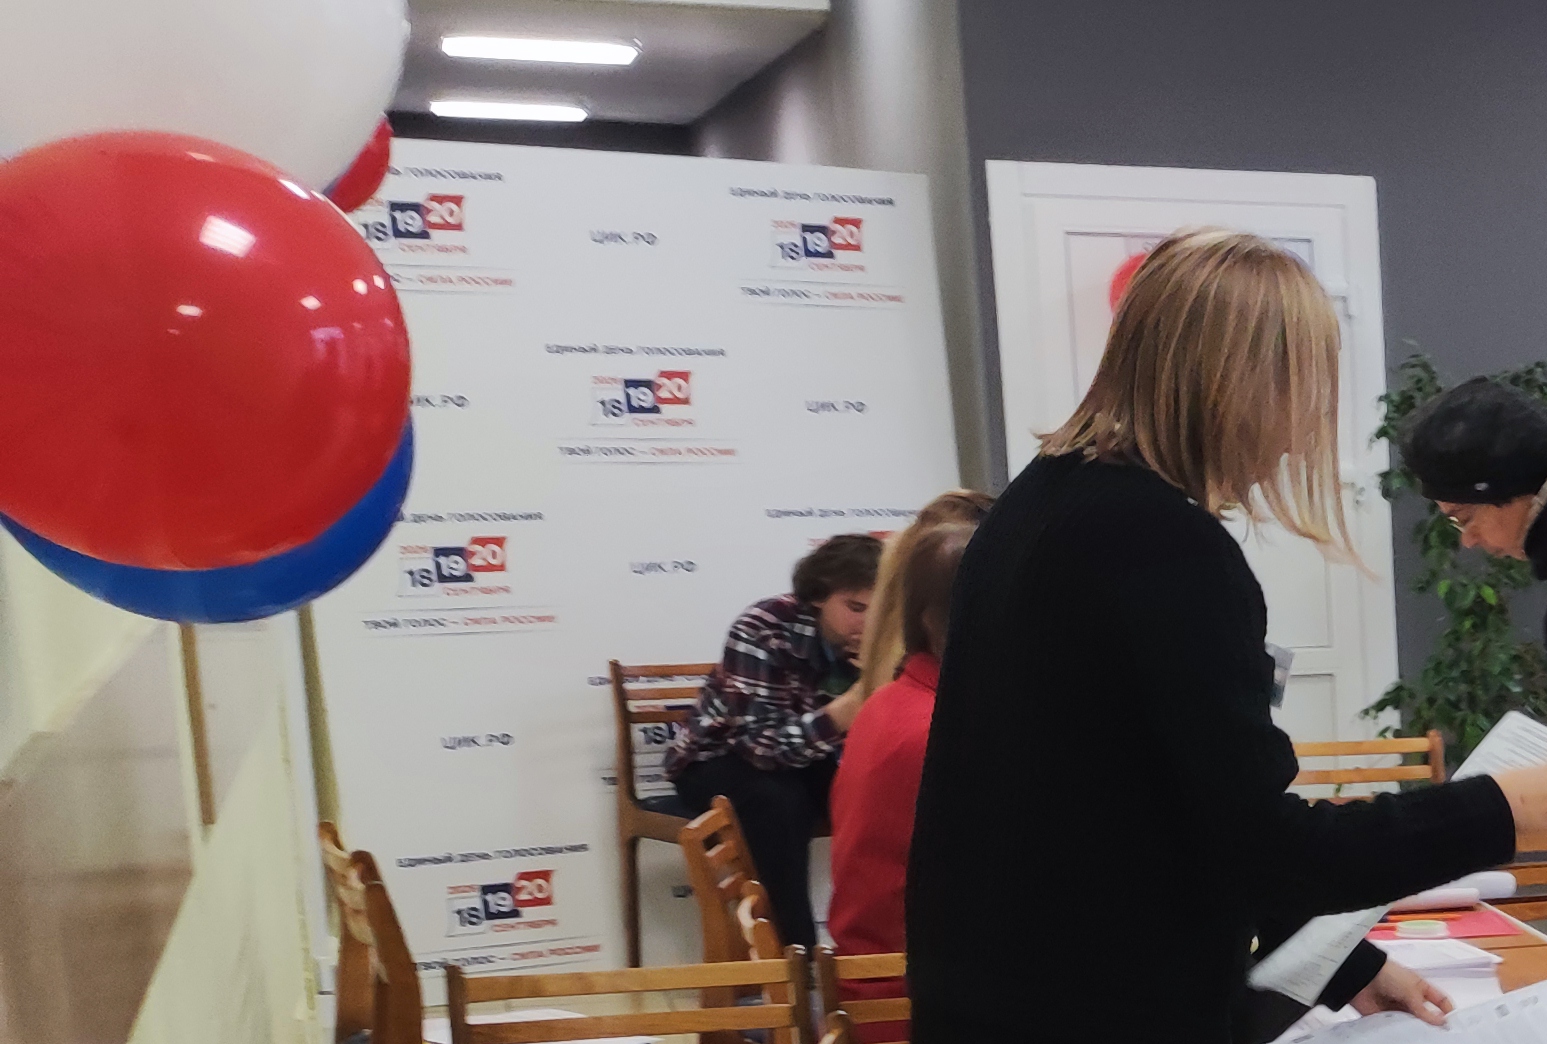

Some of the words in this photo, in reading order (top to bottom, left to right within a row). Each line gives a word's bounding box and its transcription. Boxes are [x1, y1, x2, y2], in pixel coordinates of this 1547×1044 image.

[362, 221, 391, 243] 18
[390, 209, 425, 235] 19
[422, 200, 463, 226] 20
[775, 240, 802, 261] 18
[801, 230, 830, 254] 19
[829, 223, 861, 246] 20
[410, 394, 469, 410] ИК.РФ
[597, 398, 626, 418] 18
[624, 386, 655, 409] 19
[653, 377, 692, 399] 20
[404, 567, 436, 588] 18
[434, 554, 468, 578] 19
[466, 543, 504, 567] 20
[453, 906, 485, 928] 18
[482, 891, 515, 914] 19
[514, 878, 550, 901] 20
